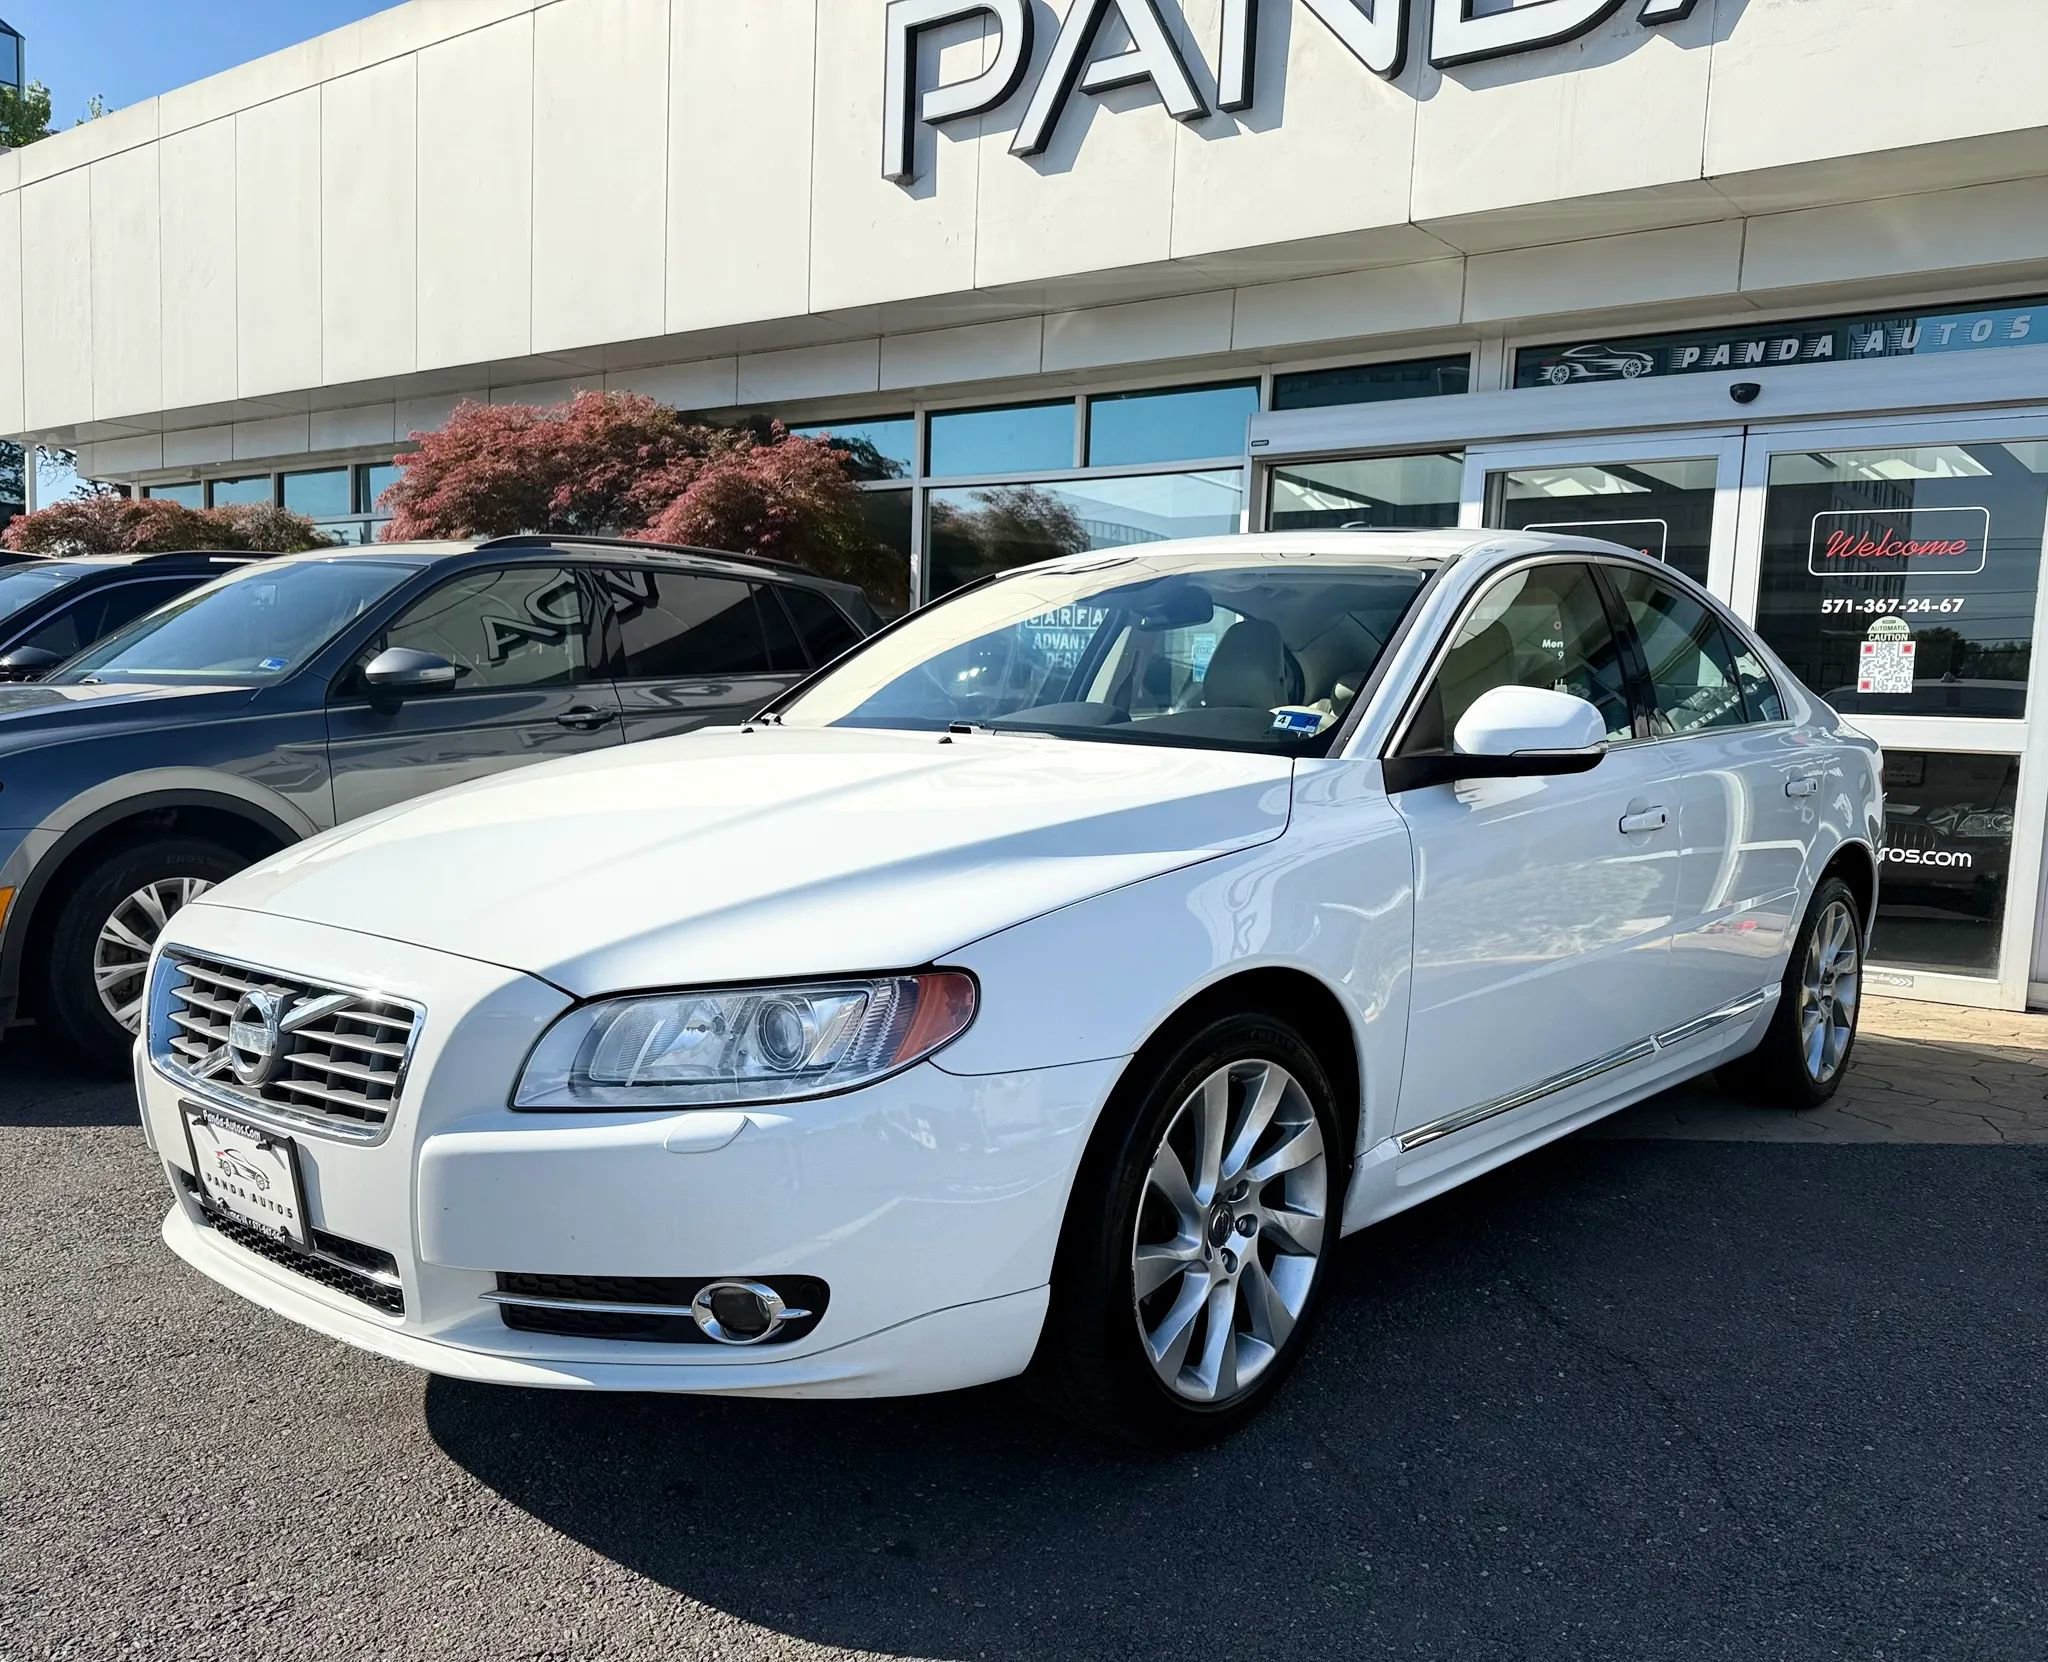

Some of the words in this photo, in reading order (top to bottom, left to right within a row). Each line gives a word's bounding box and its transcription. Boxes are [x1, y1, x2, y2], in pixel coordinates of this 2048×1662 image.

[1672, 334, 1835, 369] PANDA
[1855, 314, 2033, 354] AUTOS
[1826, 528, 1968, 558] Welcome
[1821, 598, 1965, 614] 571-367-24-67
[1541, 639, 1564, 648] Mon
[1868, 633, 1909, 641] CAUTION
[206, 1172, 246, 1199] PANDA
[251, 1193, 294, 1219] AUTOS
